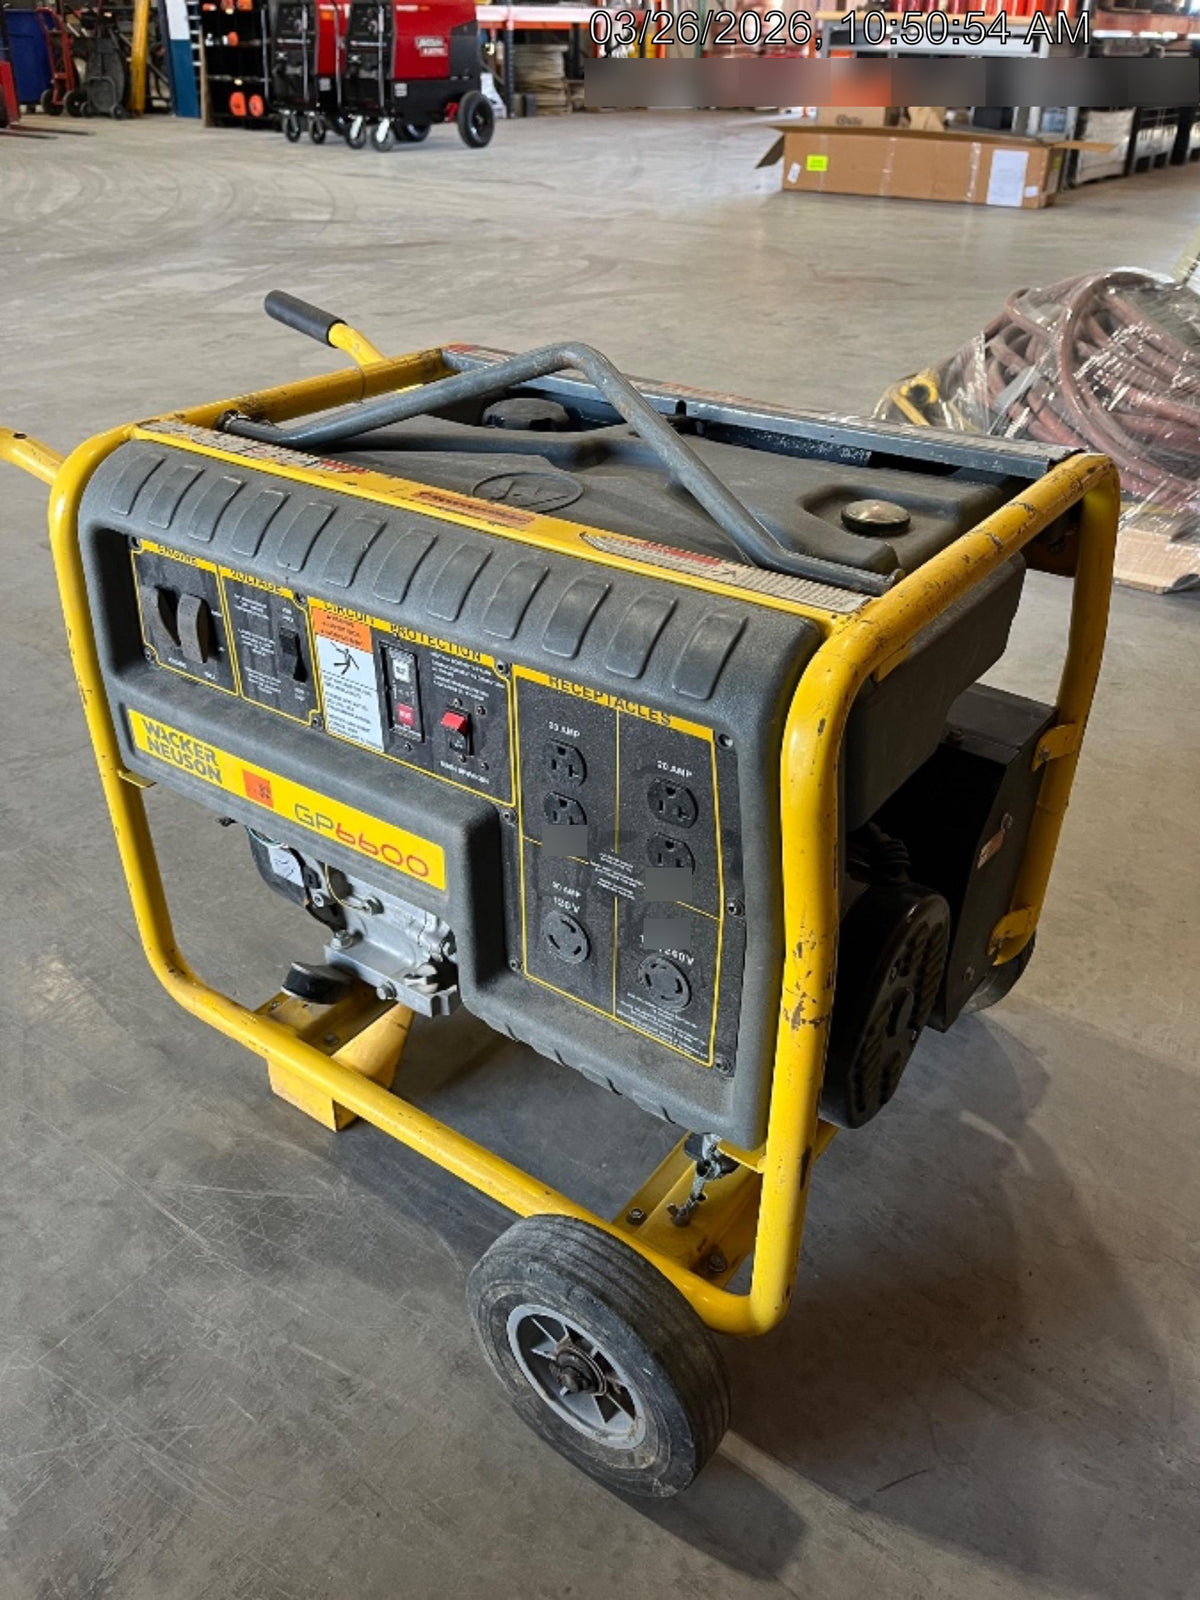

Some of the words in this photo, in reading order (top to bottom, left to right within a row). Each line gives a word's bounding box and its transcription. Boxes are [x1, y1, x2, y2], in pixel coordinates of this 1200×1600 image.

[549, 676, 672, 726] RECEPTACLES
[141, 718, 219, 766] WACKER
[146, 735, 222, 784] NEUSON
[670, 765, 693, 778] AMP
[294, 803, 429, 878] GP6600
